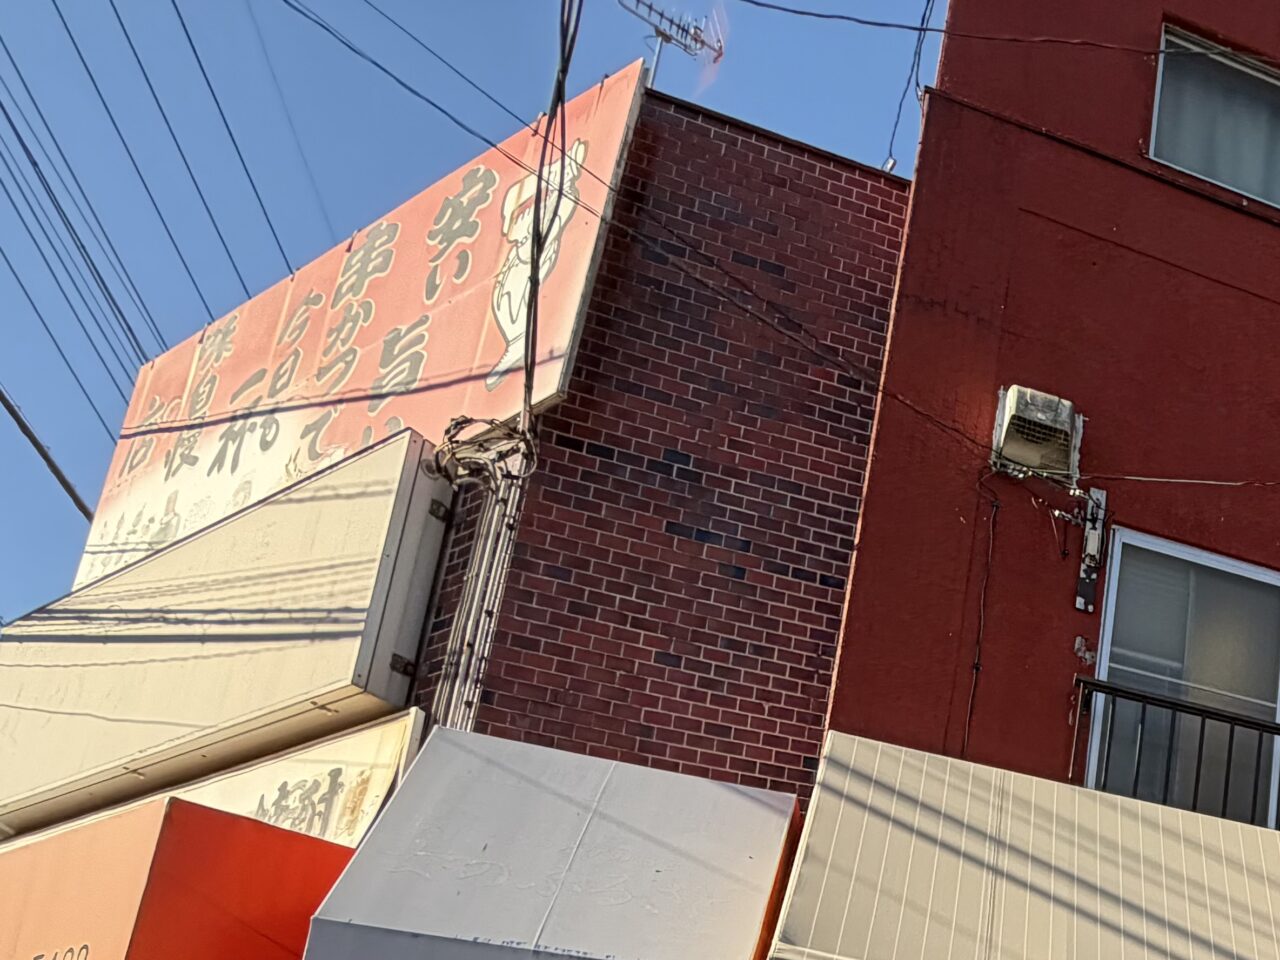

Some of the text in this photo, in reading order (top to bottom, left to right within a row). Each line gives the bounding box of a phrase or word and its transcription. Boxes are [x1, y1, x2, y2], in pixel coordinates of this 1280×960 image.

[425, 164, 498, 303] 安い
[299, 221, 399, 462] 串かつで
